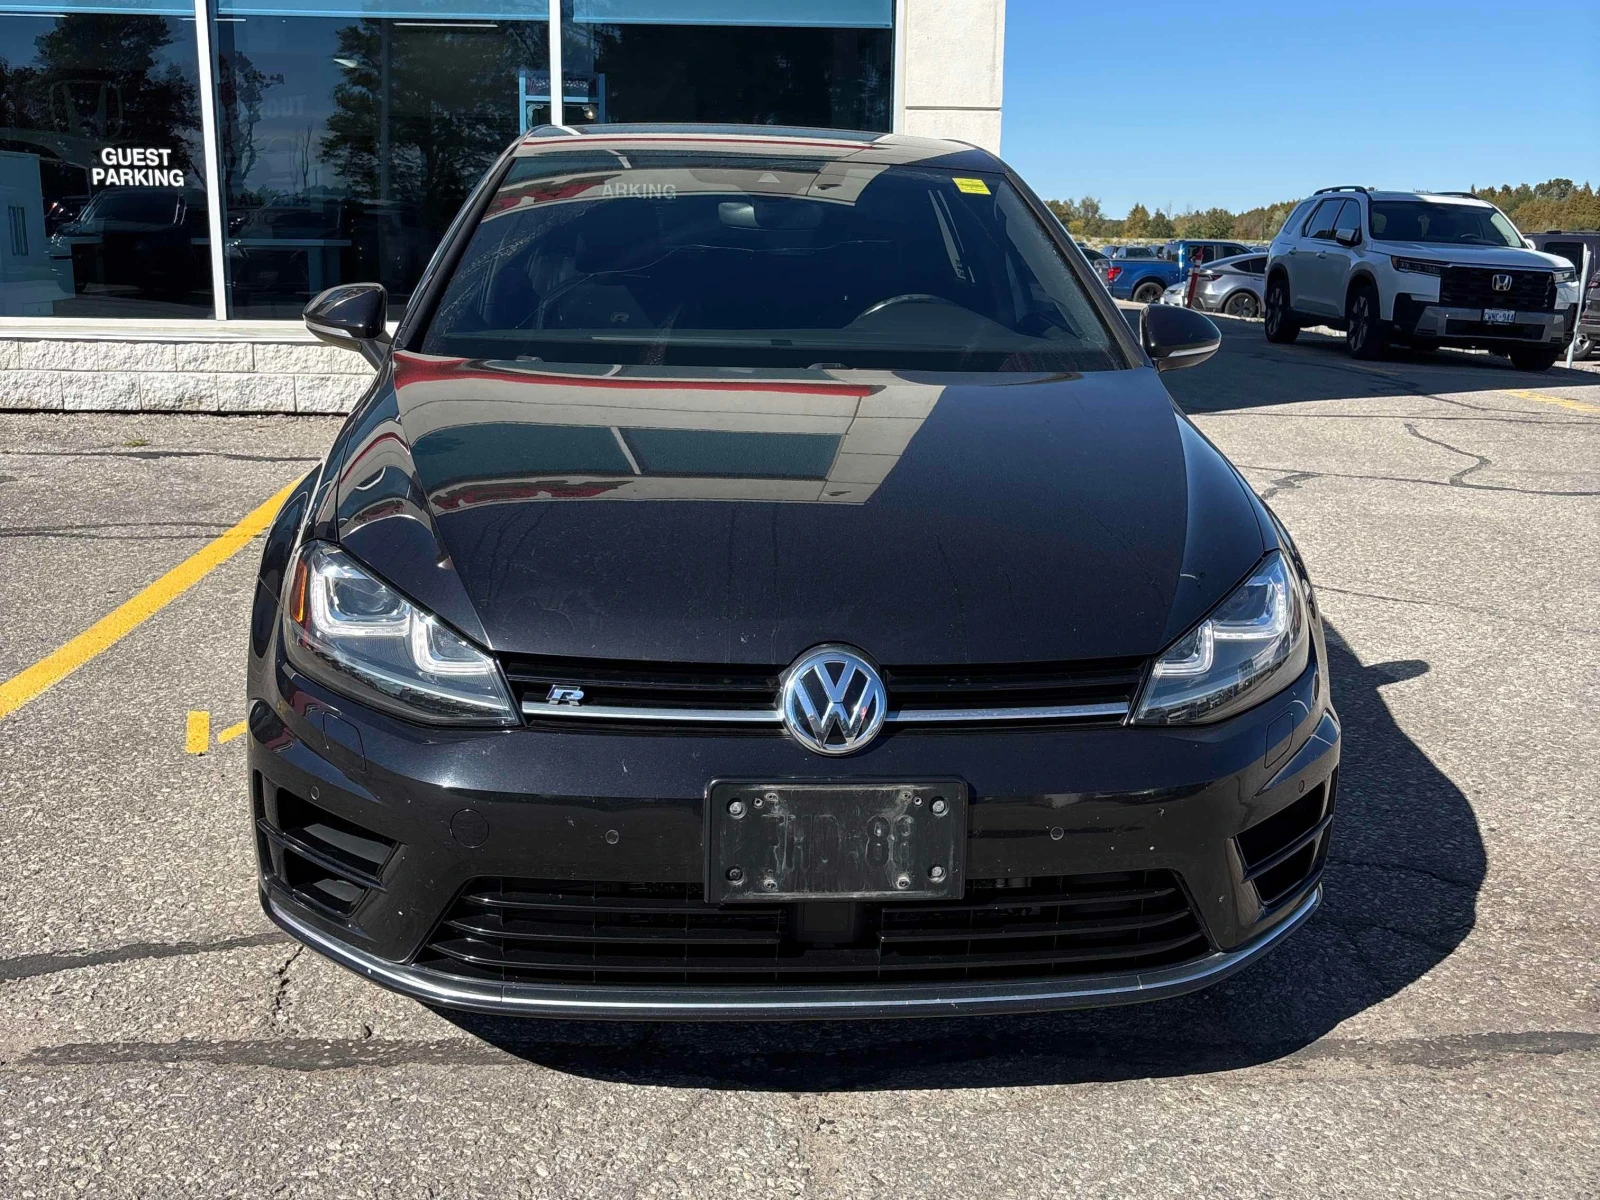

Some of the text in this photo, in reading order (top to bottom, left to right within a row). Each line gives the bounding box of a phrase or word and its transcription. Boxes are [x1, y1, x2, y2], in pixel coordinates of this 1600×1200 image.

[101, 147, 171, 166] GUEST
[92, 168, 184, 187] PARKING
[546, 684, 584, 706] R
